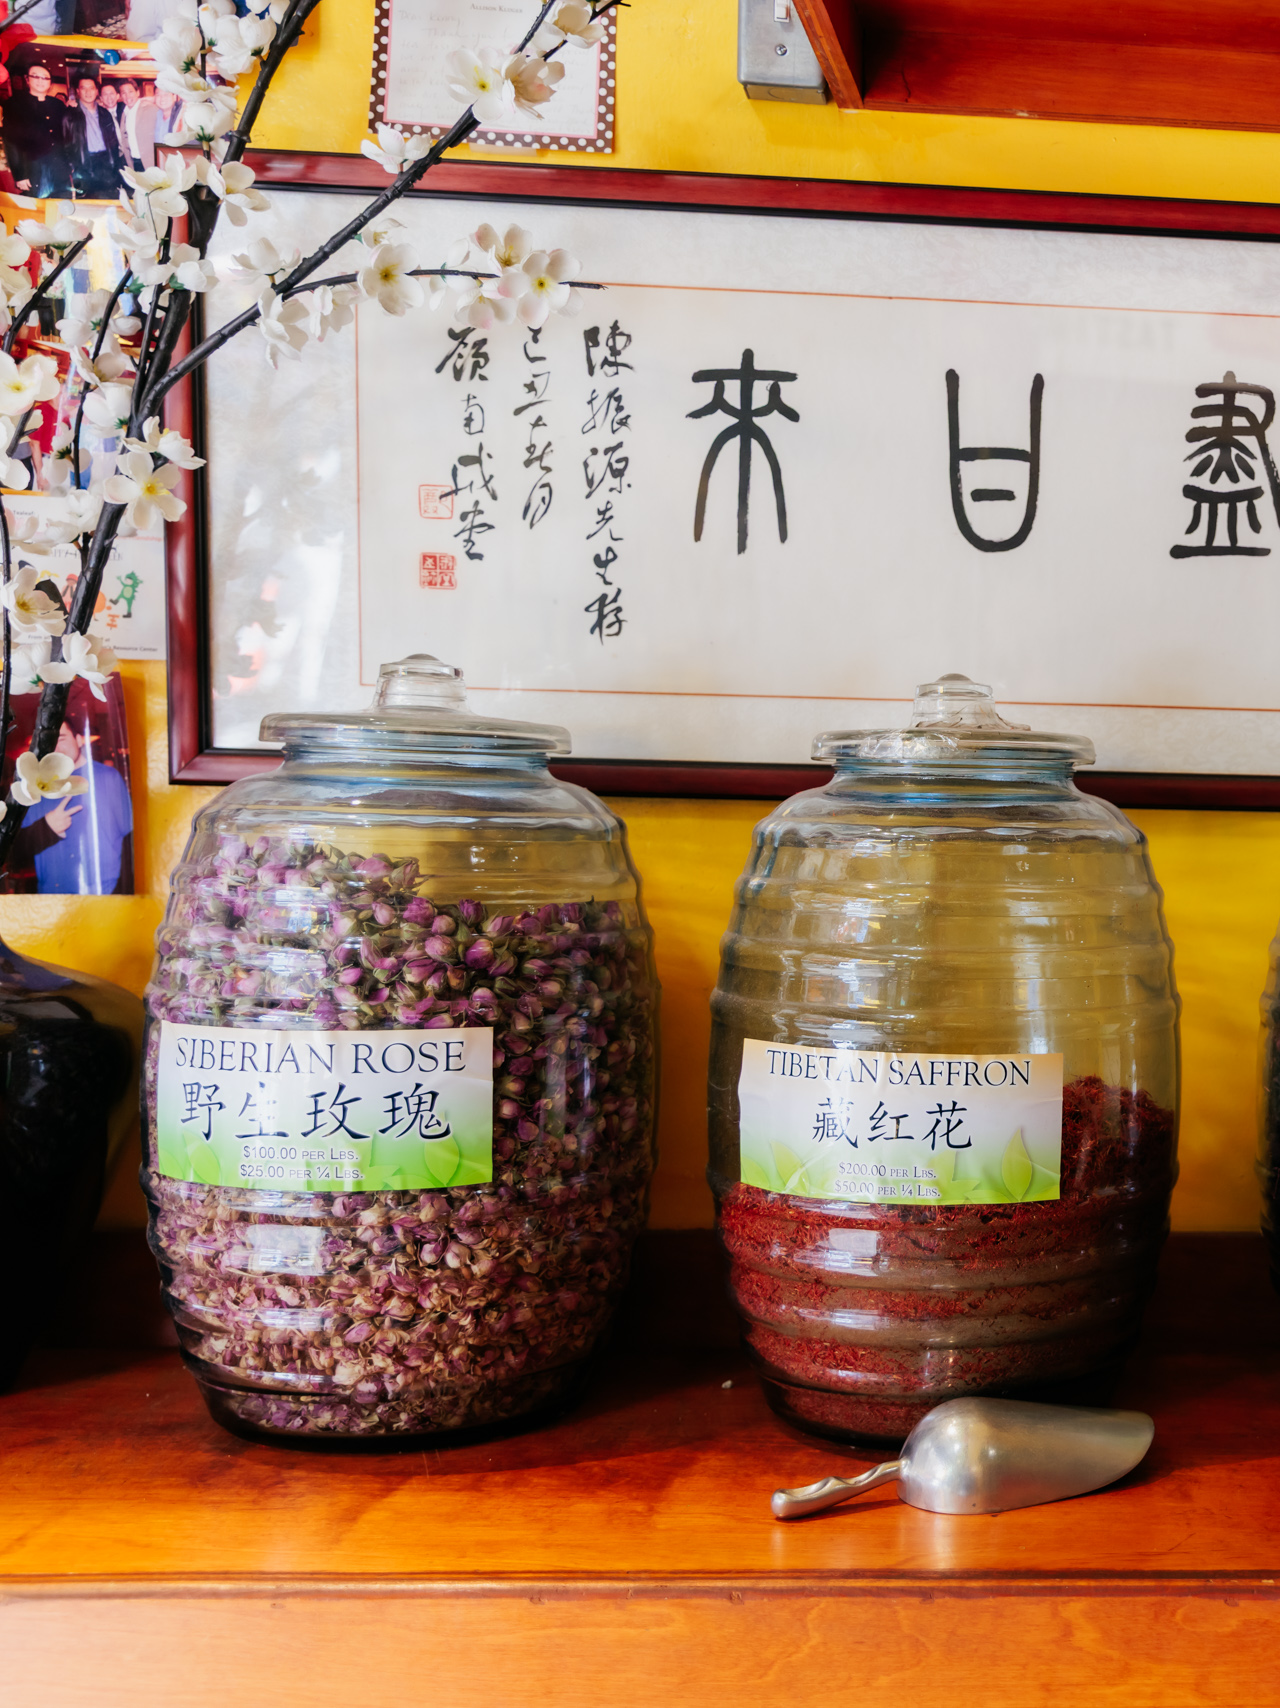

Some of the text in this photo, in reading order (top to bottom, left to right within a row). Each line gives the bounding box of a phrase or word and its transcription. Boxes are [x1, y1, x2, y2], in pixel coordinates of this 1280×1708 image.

[176, 1036, 466, 1074] SIBERIAN ROSE
[766, 1049, 1031, 1087] TIBETAN SAFFRON
[180, 1081, 452, 1142] 野生玫瑰
[811, 1096, 973, 1151] 藏红花
[243, 1145, 298, 1161] $100.00
[240, 1163, 285, 1179] $25.00
[838, 1161, 887, 1178] $200.00
[834, 1179, 874, 1194] $50.00
